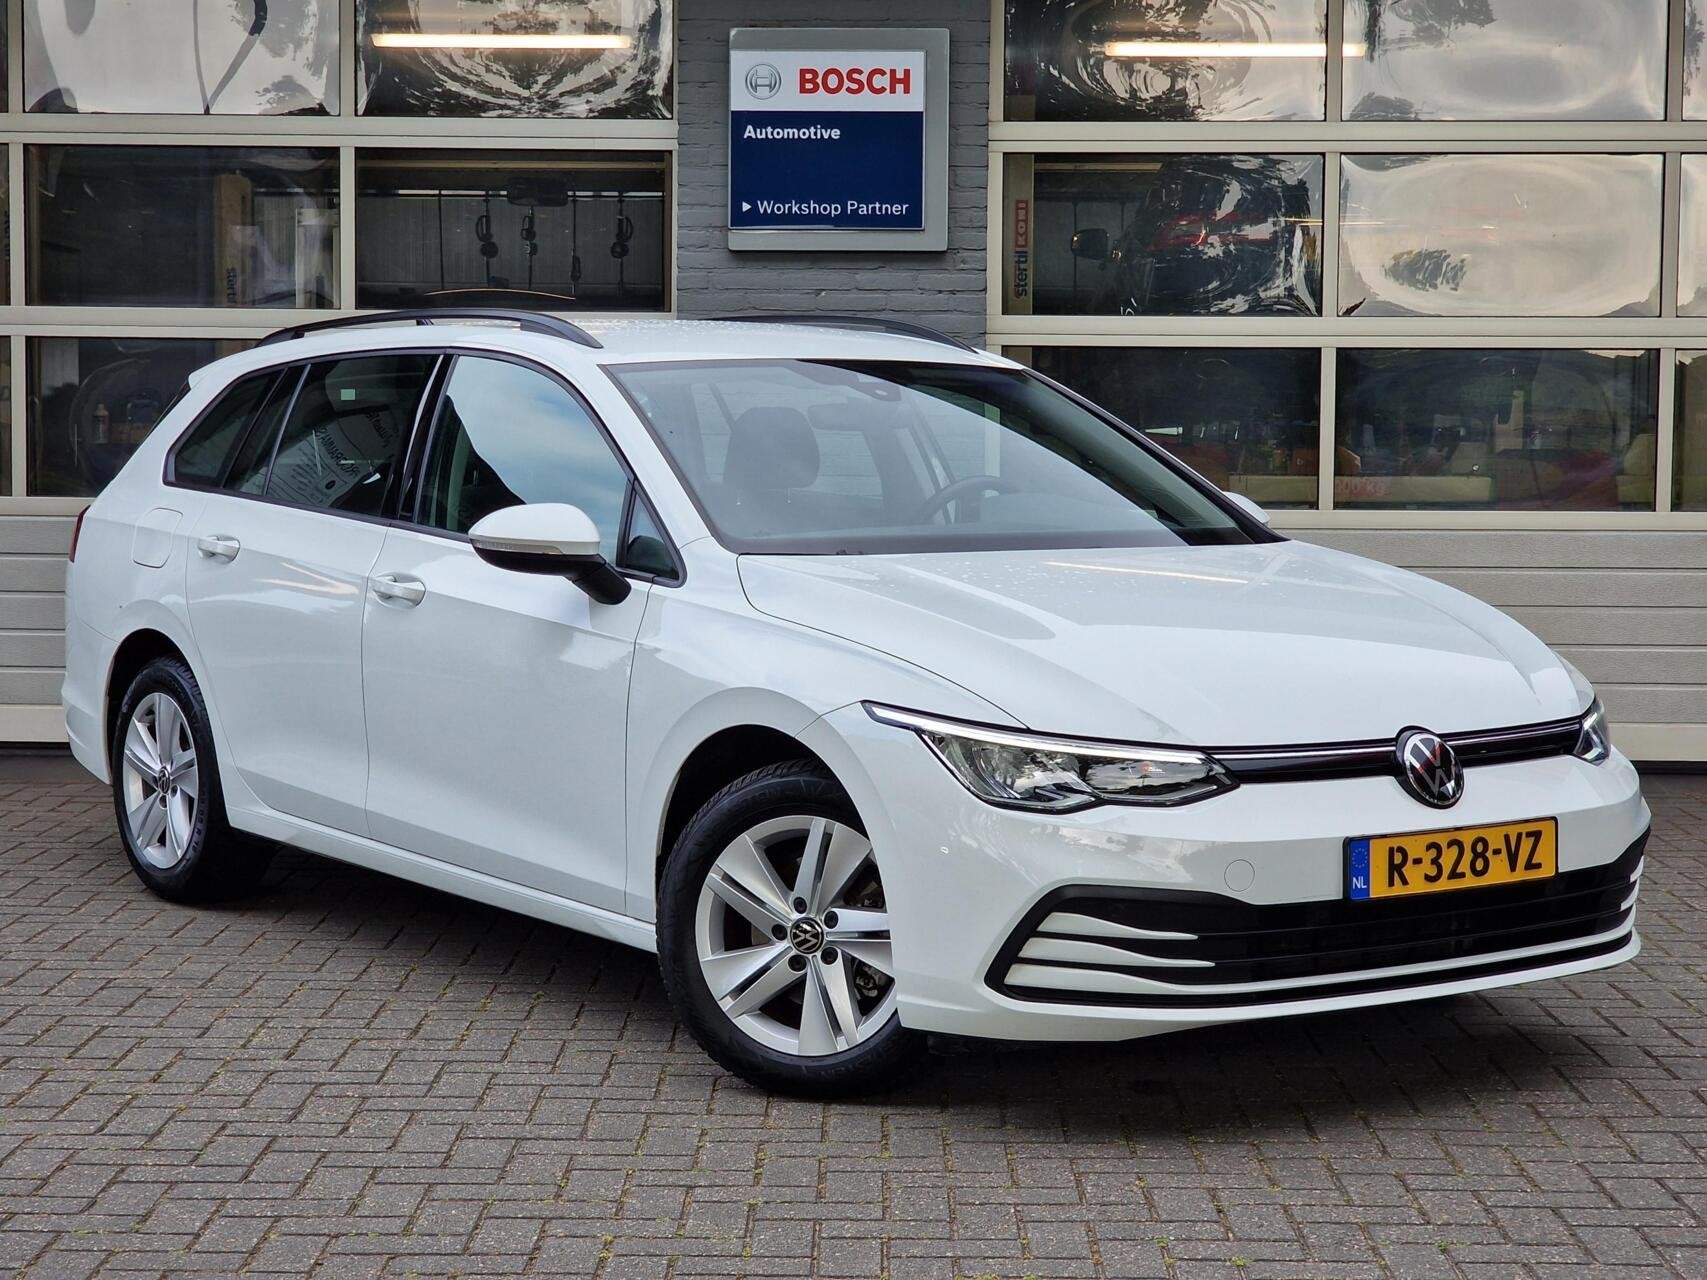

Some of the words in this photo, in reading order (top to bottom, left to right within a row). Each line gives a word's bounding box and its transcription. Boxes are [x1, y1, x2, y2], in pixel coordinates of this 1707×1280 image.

[798, 67, 911, 95] BOSCH
[743, 125, 841, 139] Automotive
[757, 200, 841, 217] Workshop
[847, 200, 909, 215] Partner
[1014, 250, 1028, 299] stertil
[1387, 829, 1543, 888] R-328-VZ
[1352, 876, 1368, 889] NL
